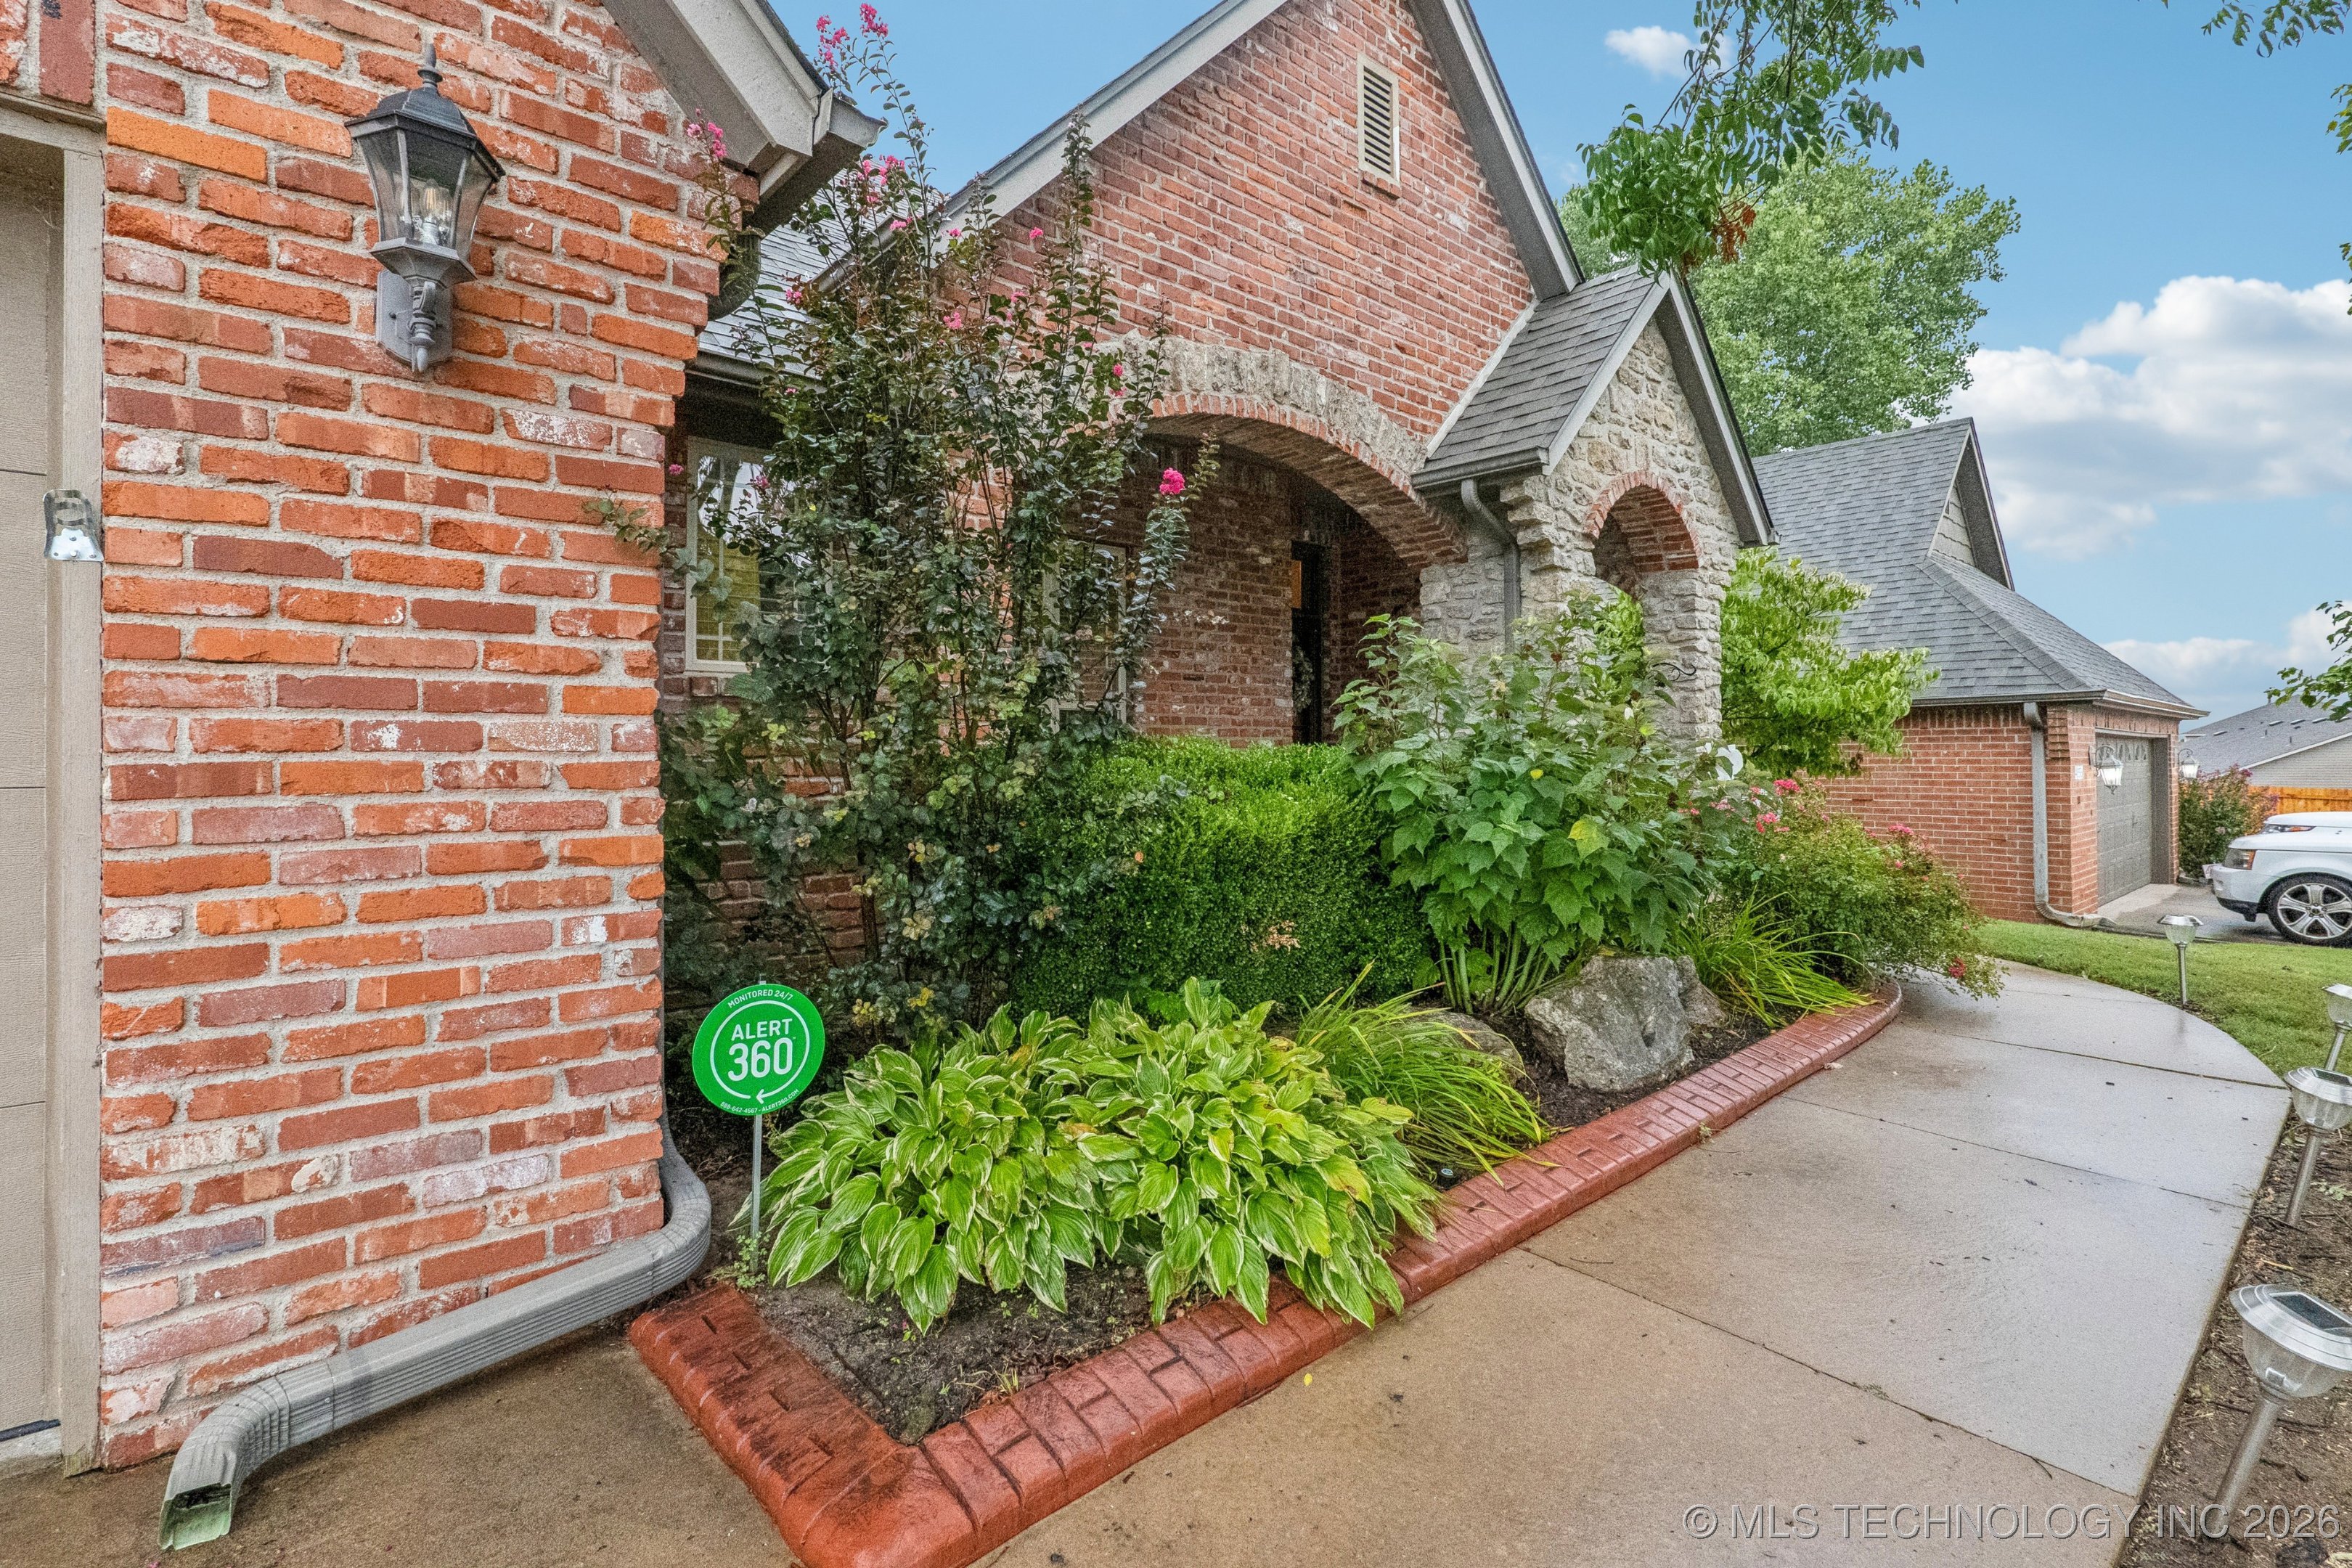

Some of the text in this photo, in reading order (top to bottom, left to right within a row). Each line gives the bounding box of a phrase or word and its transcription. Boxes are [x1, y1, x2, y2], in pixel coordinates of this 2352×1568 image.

[727, 989, 793, 1008] MONITORED 24/7
[730, 1018, 793, 1041] ALERT
[727, 1037, 793, 1082] 360
[720, 1101, 758, 1113] 888-642-4567
[761, 1088, 799, 1111] ALERT360.COM
